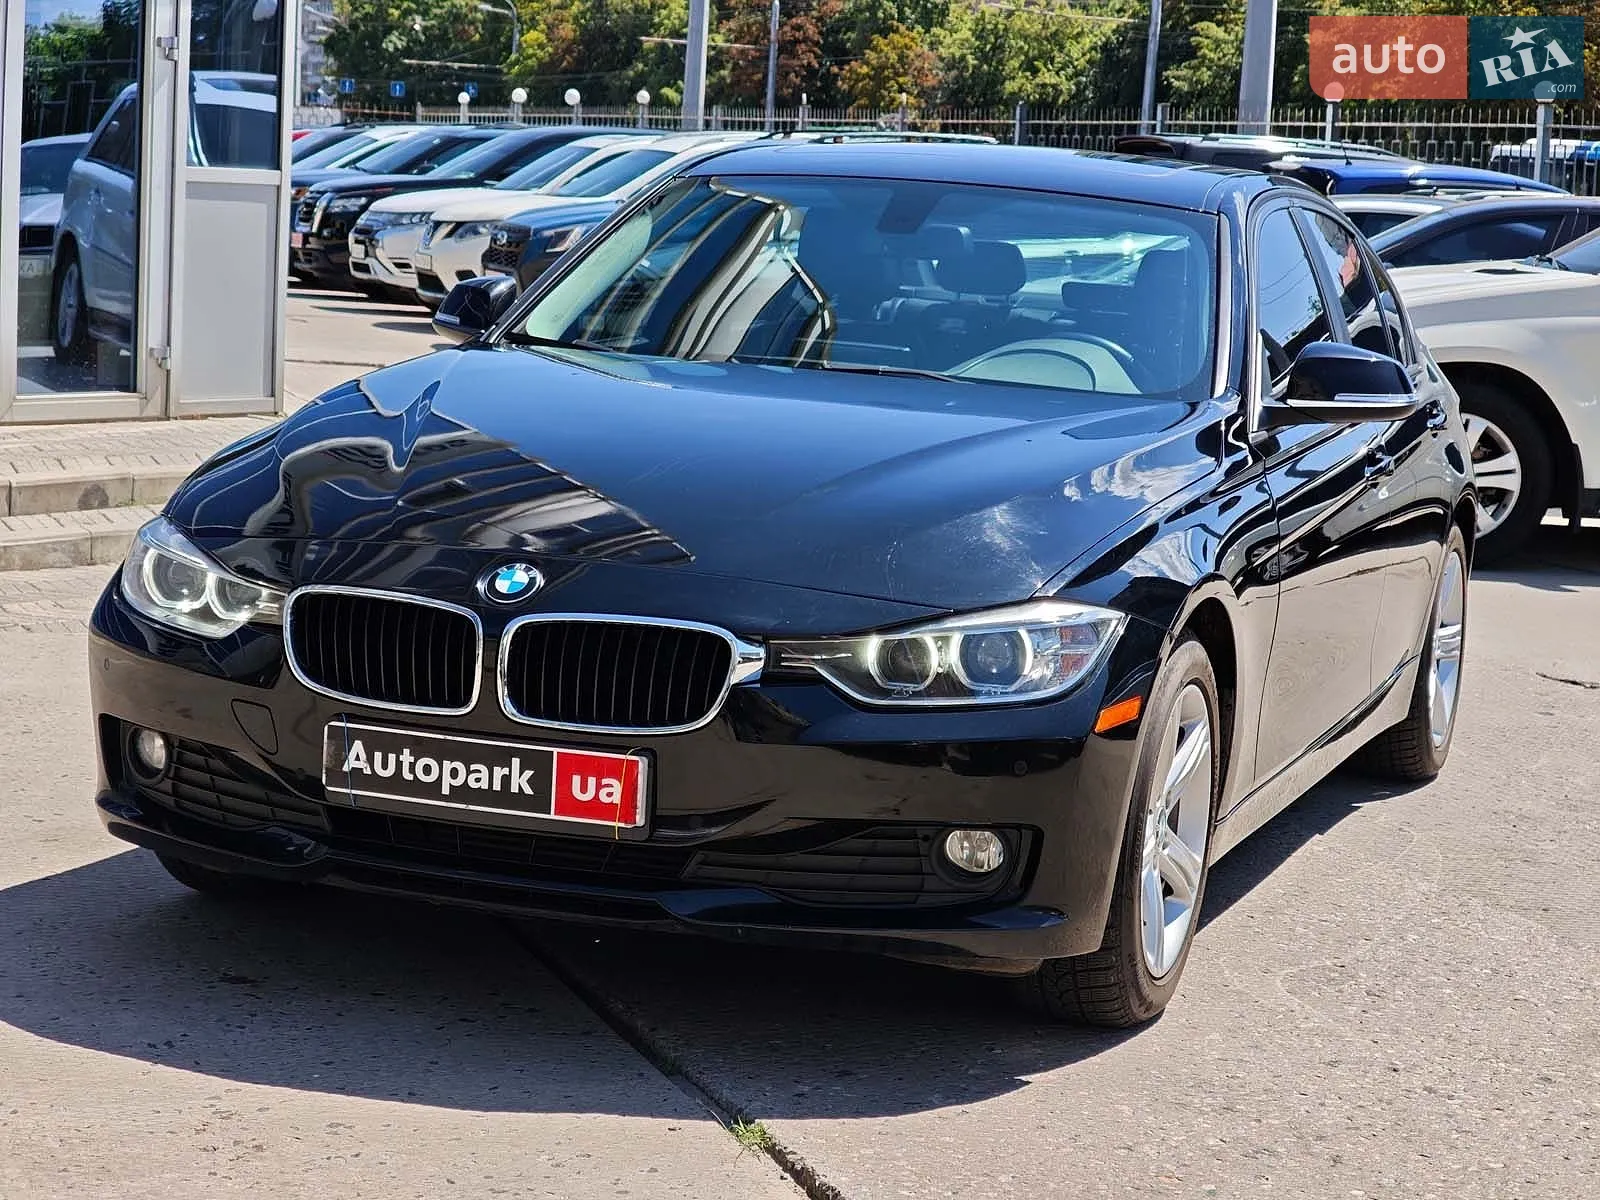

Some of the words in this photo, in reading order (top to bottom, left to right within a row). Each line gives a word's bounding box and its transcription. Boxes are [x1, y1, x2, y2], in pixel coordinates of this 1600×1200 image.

[496, 563, 537, 578] BMW
[342, 739, 535, 795] Autopark
[571, 773, 622, 805] ua
